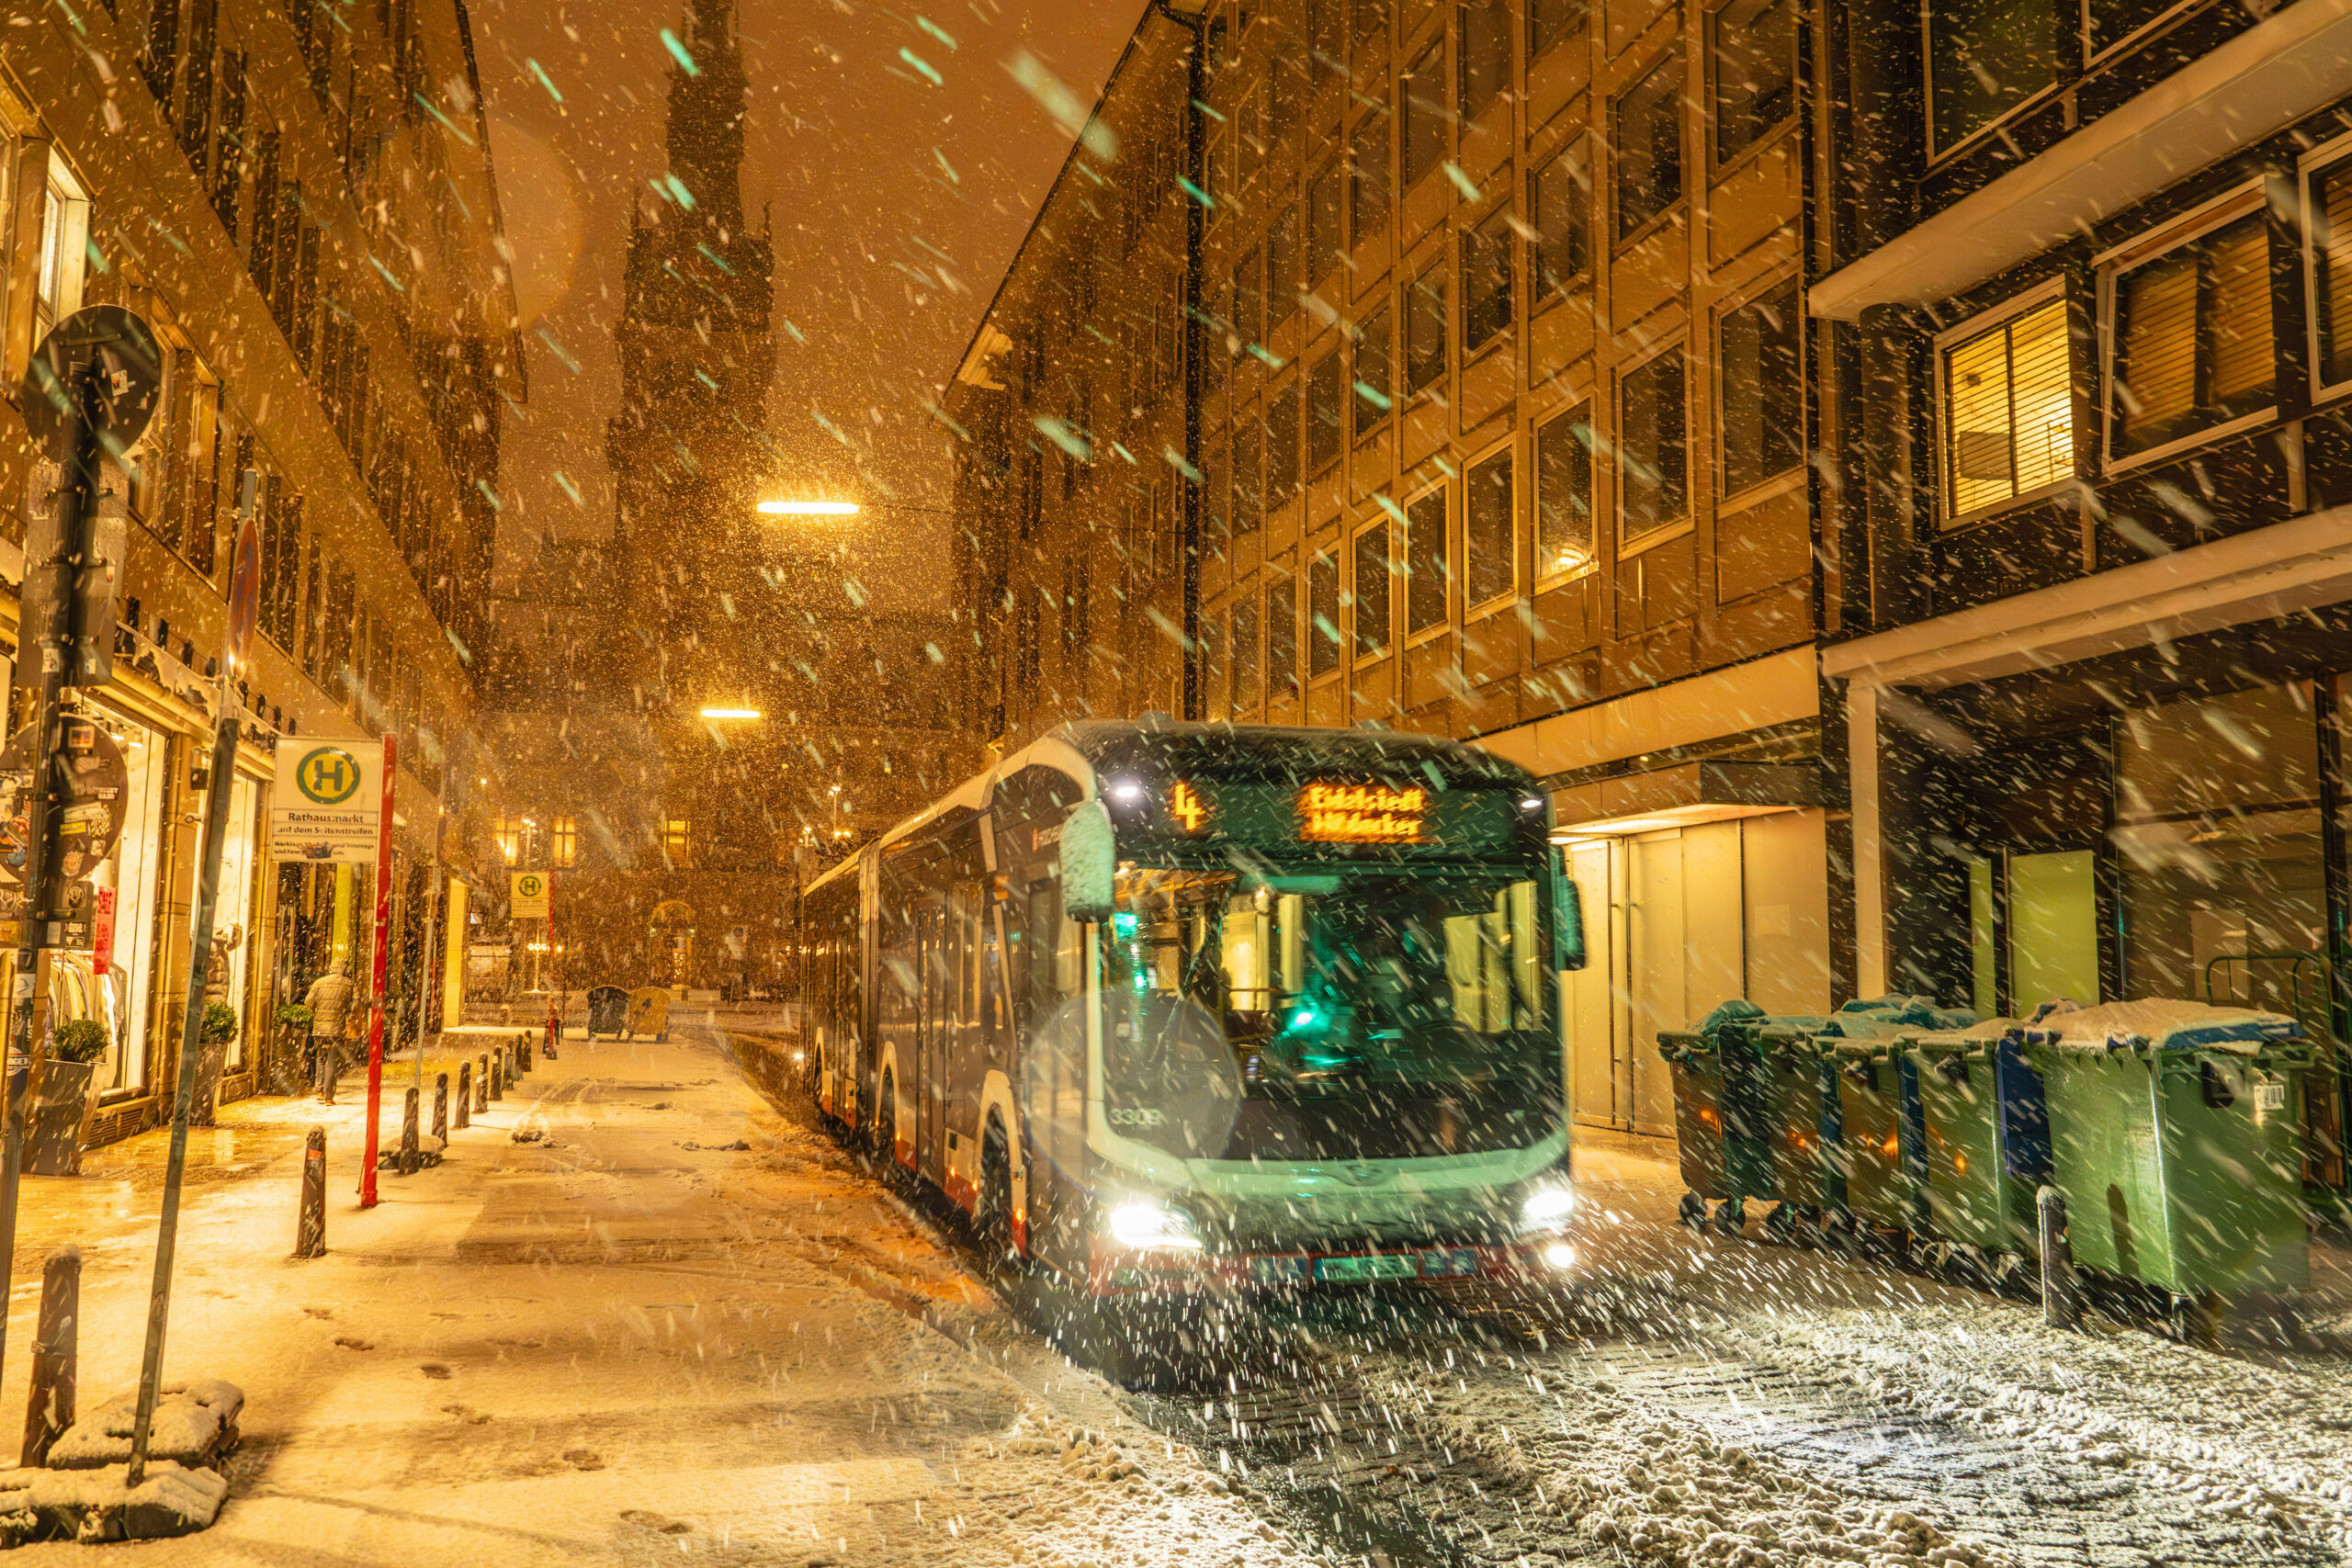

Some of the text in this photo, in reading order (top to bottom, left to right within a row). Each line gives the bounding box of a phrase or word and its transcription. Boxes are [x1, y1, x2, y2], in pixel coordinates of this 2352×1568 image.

[313, 760, 344, 792] H
[288, 812, 364, 824] Rathausmarkt
[1174, 784, 1203, 831] 4
[293, 826, 313, 834] dem
